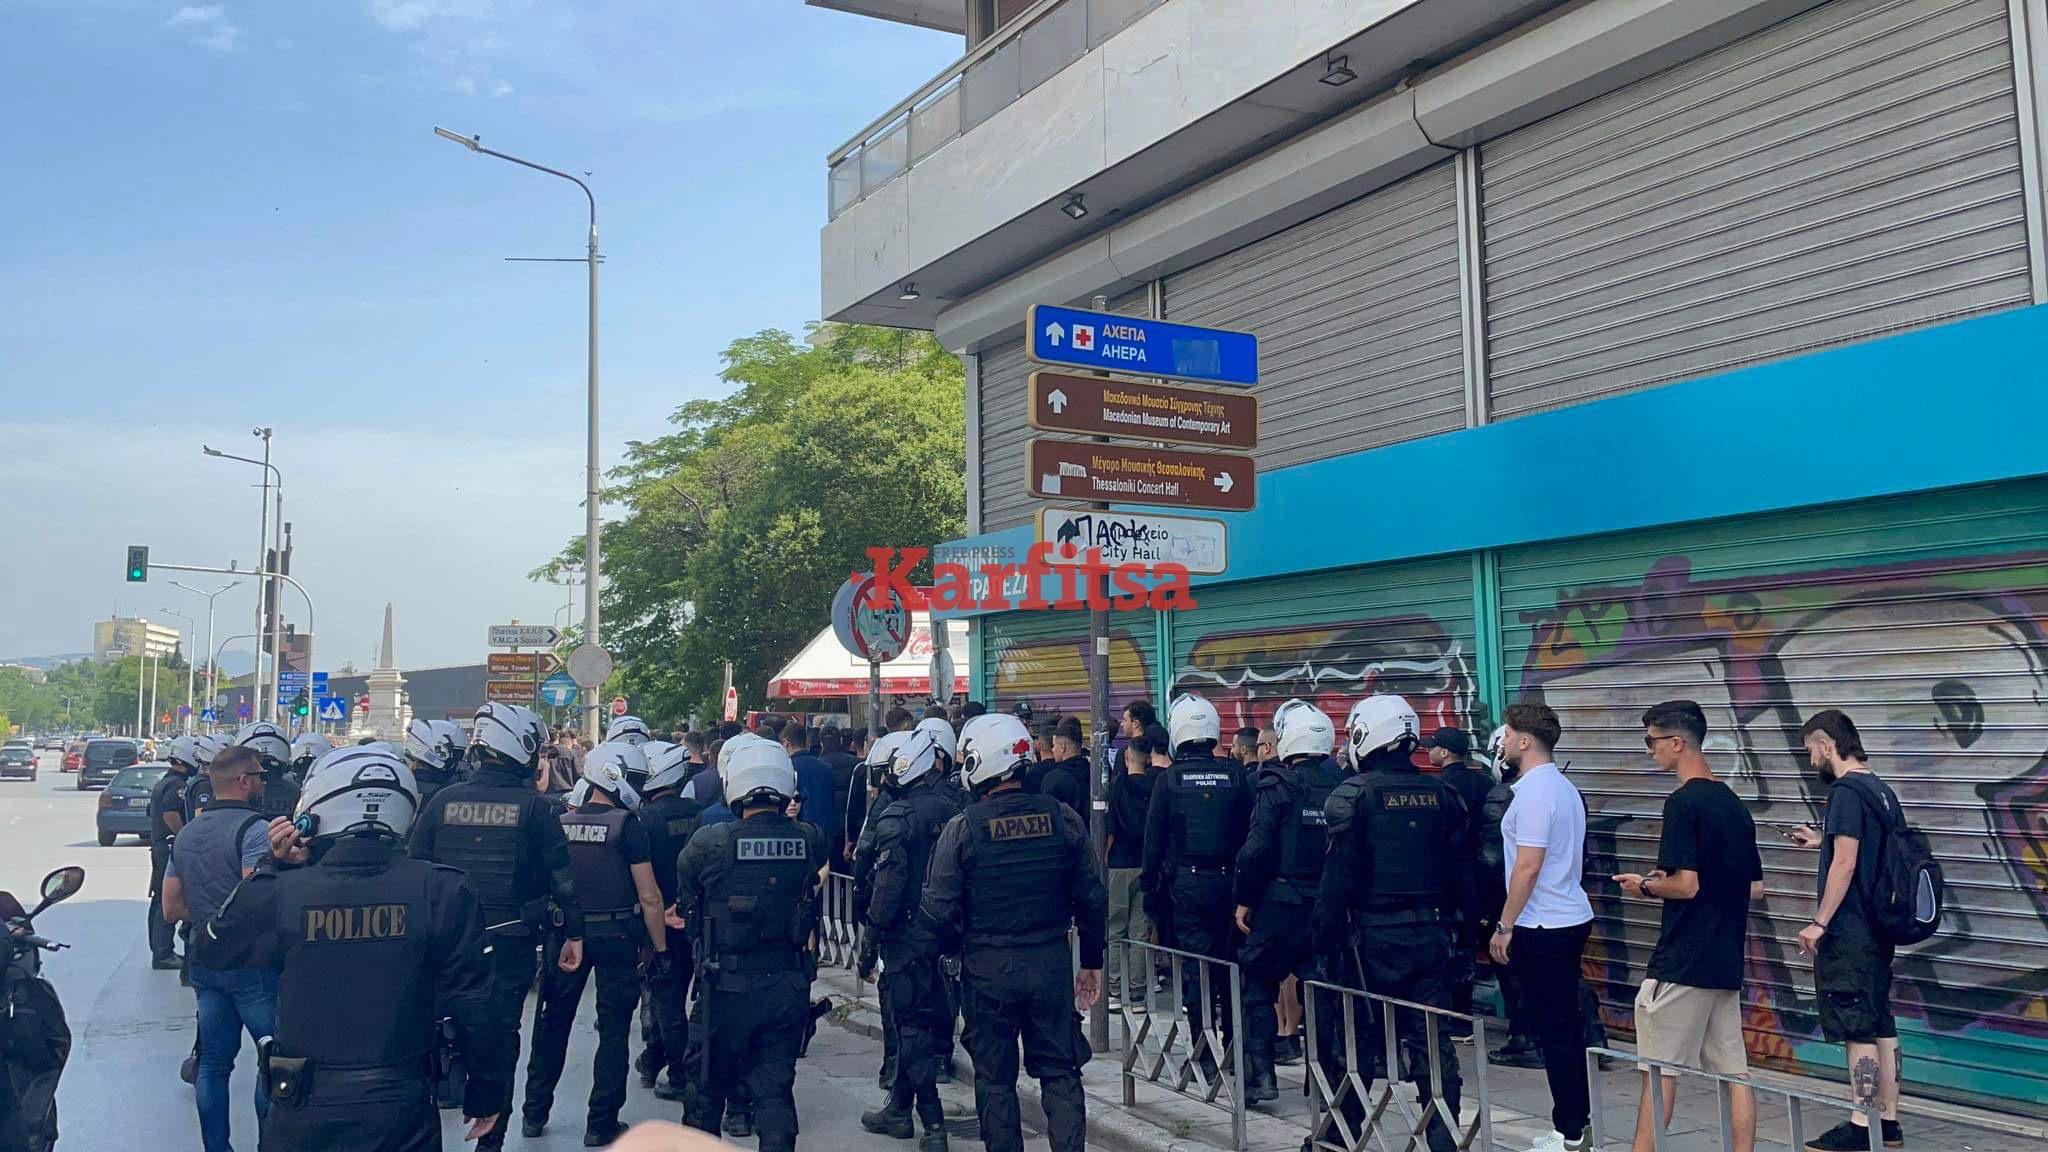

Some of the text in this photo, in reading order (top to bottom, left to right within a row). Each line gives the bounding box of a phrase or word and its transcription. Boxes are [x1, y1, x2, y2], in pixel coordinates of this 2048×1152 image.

[1102, 323, 1146, 342] ΑΧΕΠΑ
[1101, 344, 1147, 362] AHEPA
[1103, 389, 1225, 417] Μακεδονικό Μουσείο Σύγχρονης Τέχνης
[1103, 408, 1231, 436] Macedonian Museum of Contemporary Art
[1092, 456, 1206, 481] Μέγαρο Μουσικής Θεσσαλονίκης
[1092, 476, 1179, 496] Thessaloniki Concert Hall
[1102, 544, 1161, 561] City Hall
[1387, 794, 1437, 807] ΔΡΑΣΗ
[447, 803, 518, 825] POLICE
[562, 824, 609, 843] POLICE
[994, 815, 1050, 840] ΔΡΑΣΗ
[741, 840, 803, 857] POLICE
[306, 905, 406, 941] POLICE
